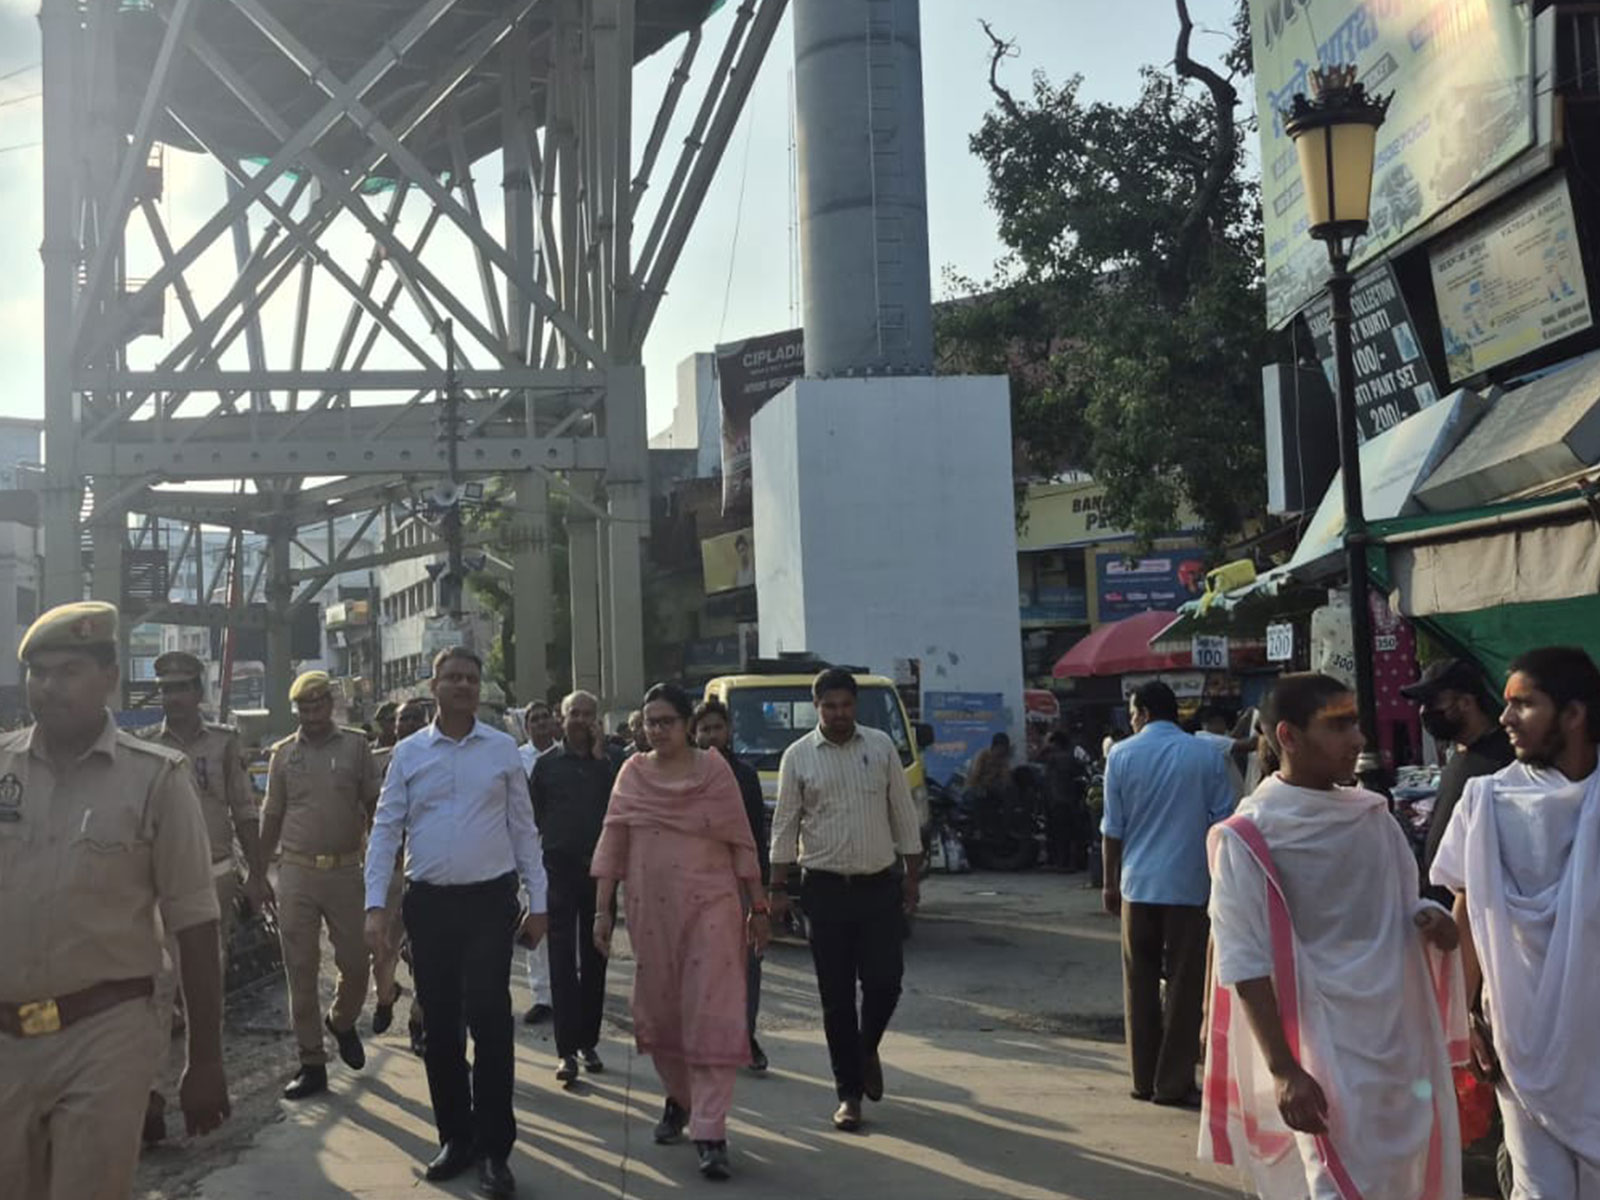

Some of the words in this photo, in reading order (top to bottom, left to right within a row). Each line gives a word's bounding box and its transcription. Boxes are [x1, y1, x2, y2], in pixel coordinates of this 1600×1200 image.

[1359, 309, 1391, 340] KURTI
[1369, 373, 1398, 400] PANT
[1396, 364, 1418, 389] SET
[1197, 649, 1223, 666] 100
